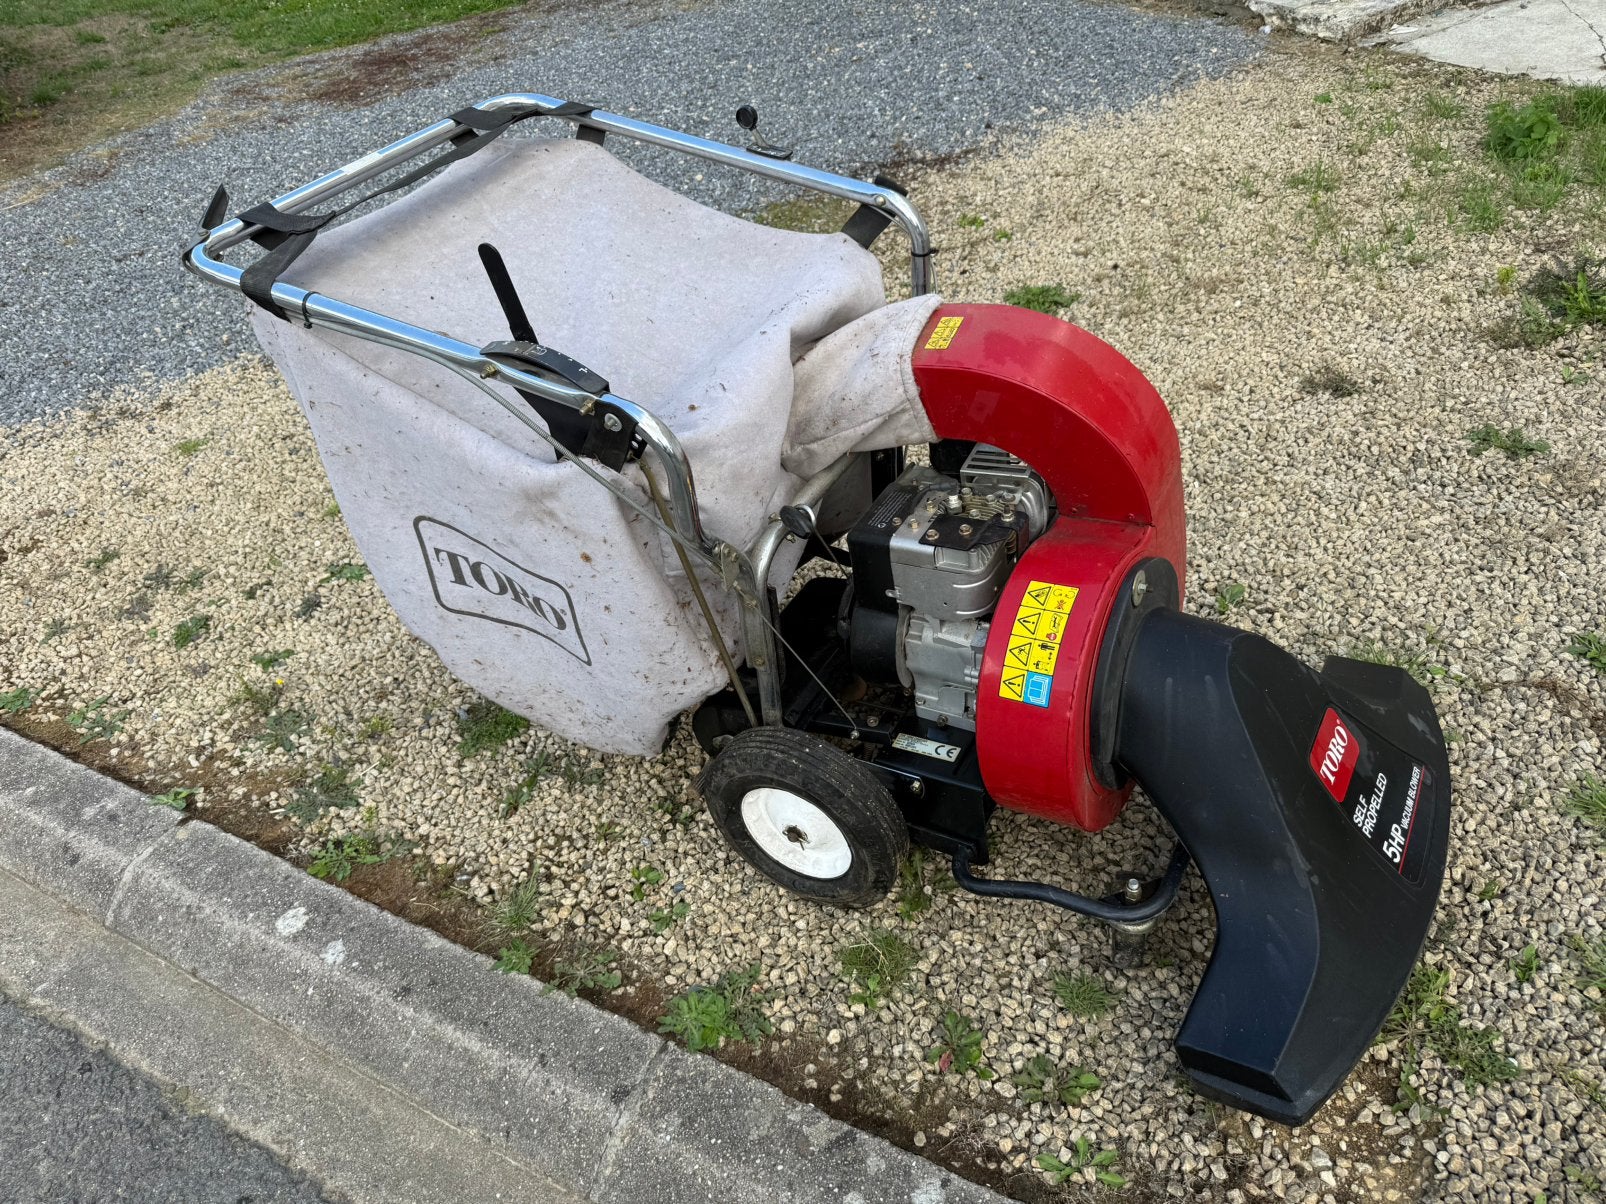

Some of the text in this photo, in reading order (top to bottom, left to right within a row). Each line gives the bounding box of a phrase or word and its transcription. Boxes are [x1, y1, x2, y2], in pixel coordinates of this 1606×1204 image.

[433, 547, 567, 630] TORO
[1320, 725, 1348, 785] TORO
[1353, 794, 1370, 827] SELF
[1362, 772, 1387, 839] PROPELLED
[1382, 766, 1421, 863] 5HP VACUUM BLOWER
